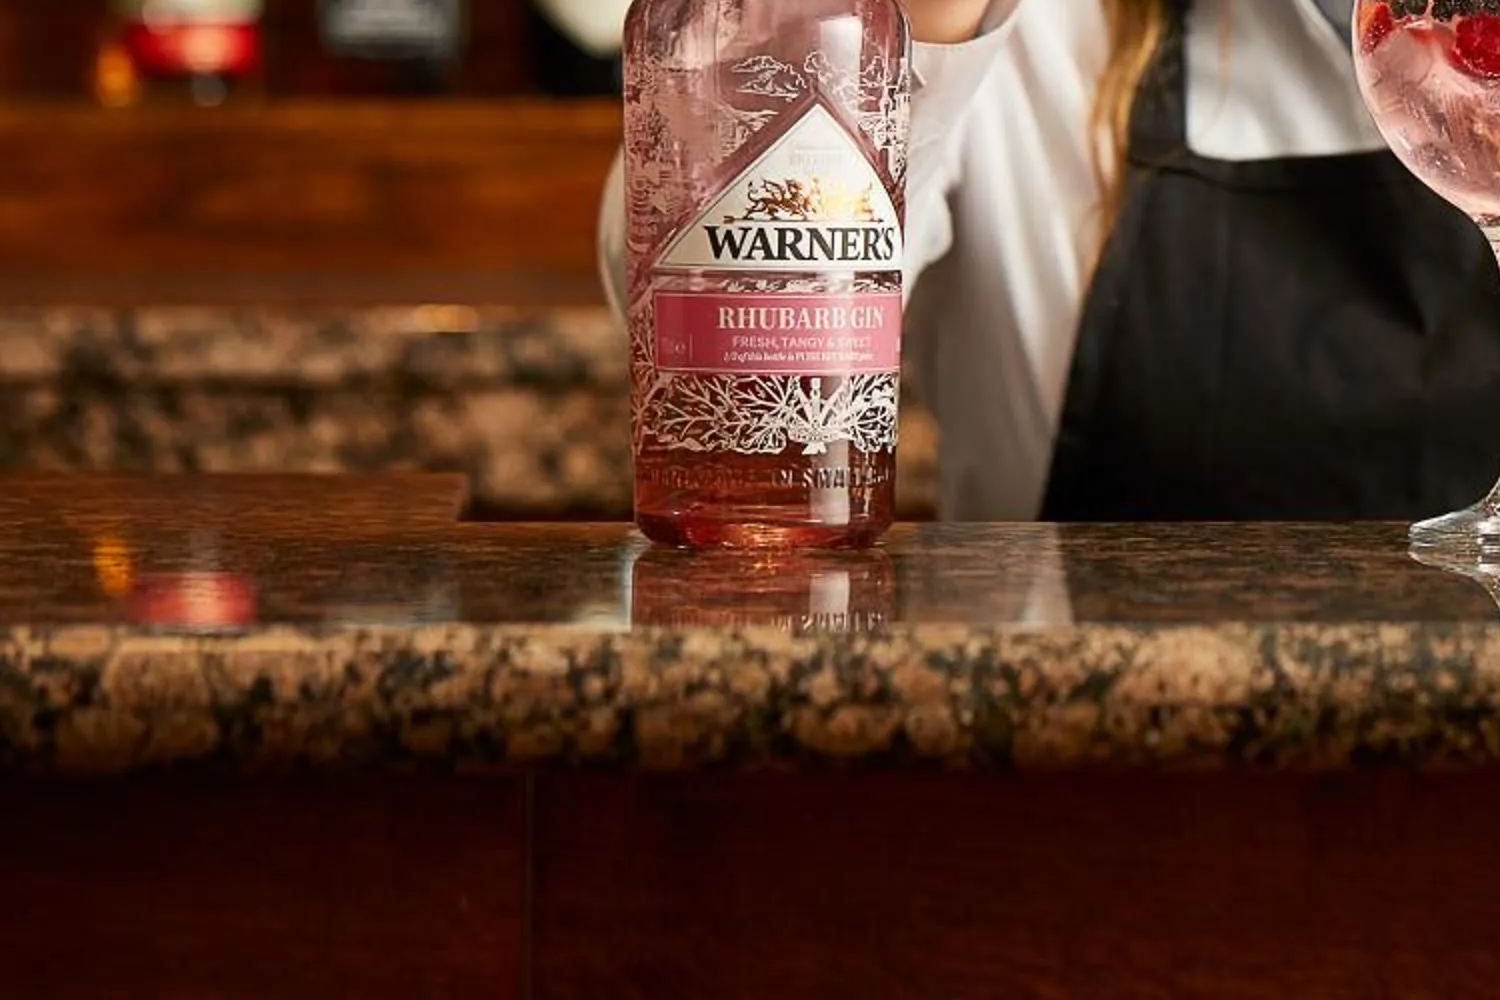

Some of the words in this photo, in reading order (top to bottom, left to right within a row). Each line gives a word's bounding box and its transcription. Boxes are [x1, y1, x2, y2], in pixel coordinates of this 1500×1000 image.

[703, 225, 895, 261] WARNER'S
[718, 306, 847, 330] RHUBARB
[850, 306, 885, 330] GIN
[782, 336, 824, 349] TANGY
